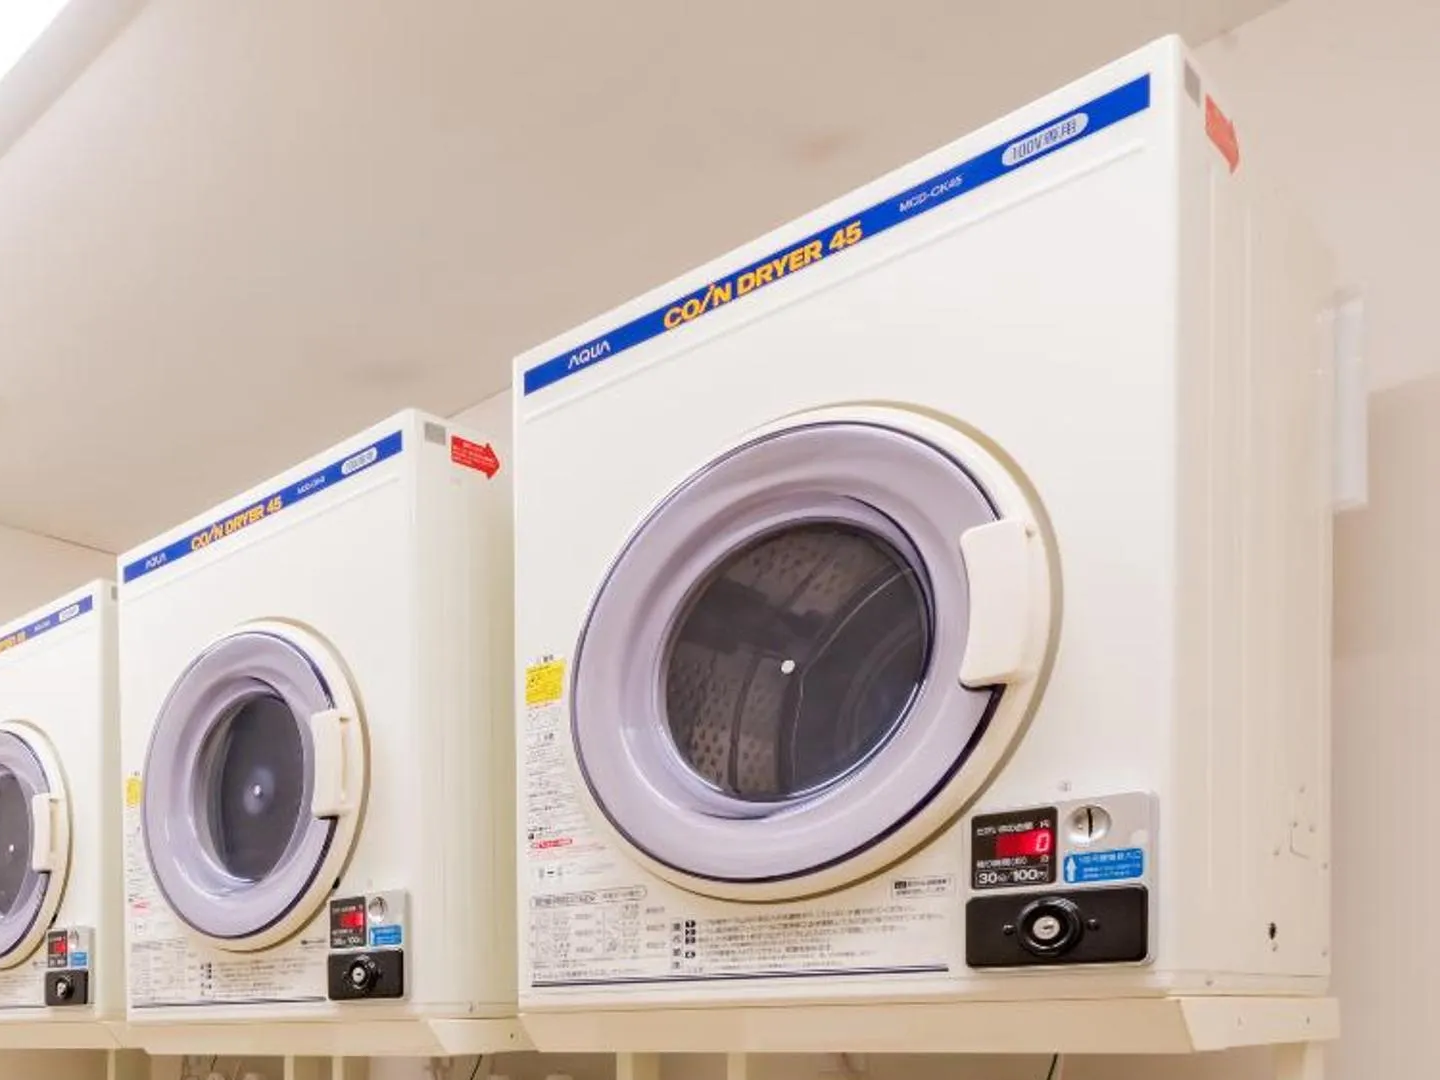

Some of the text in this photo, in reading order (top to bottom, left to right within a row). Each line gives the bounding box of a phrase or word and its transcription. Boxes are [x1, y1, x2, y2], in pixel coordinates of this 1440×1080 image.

[664, 221, 863, 328] COIN DRYER 45
[568, 340, 610, 369] AQUA
[266, 496, 283, 514] 45
[1036, 833, 1050, 852] 0
